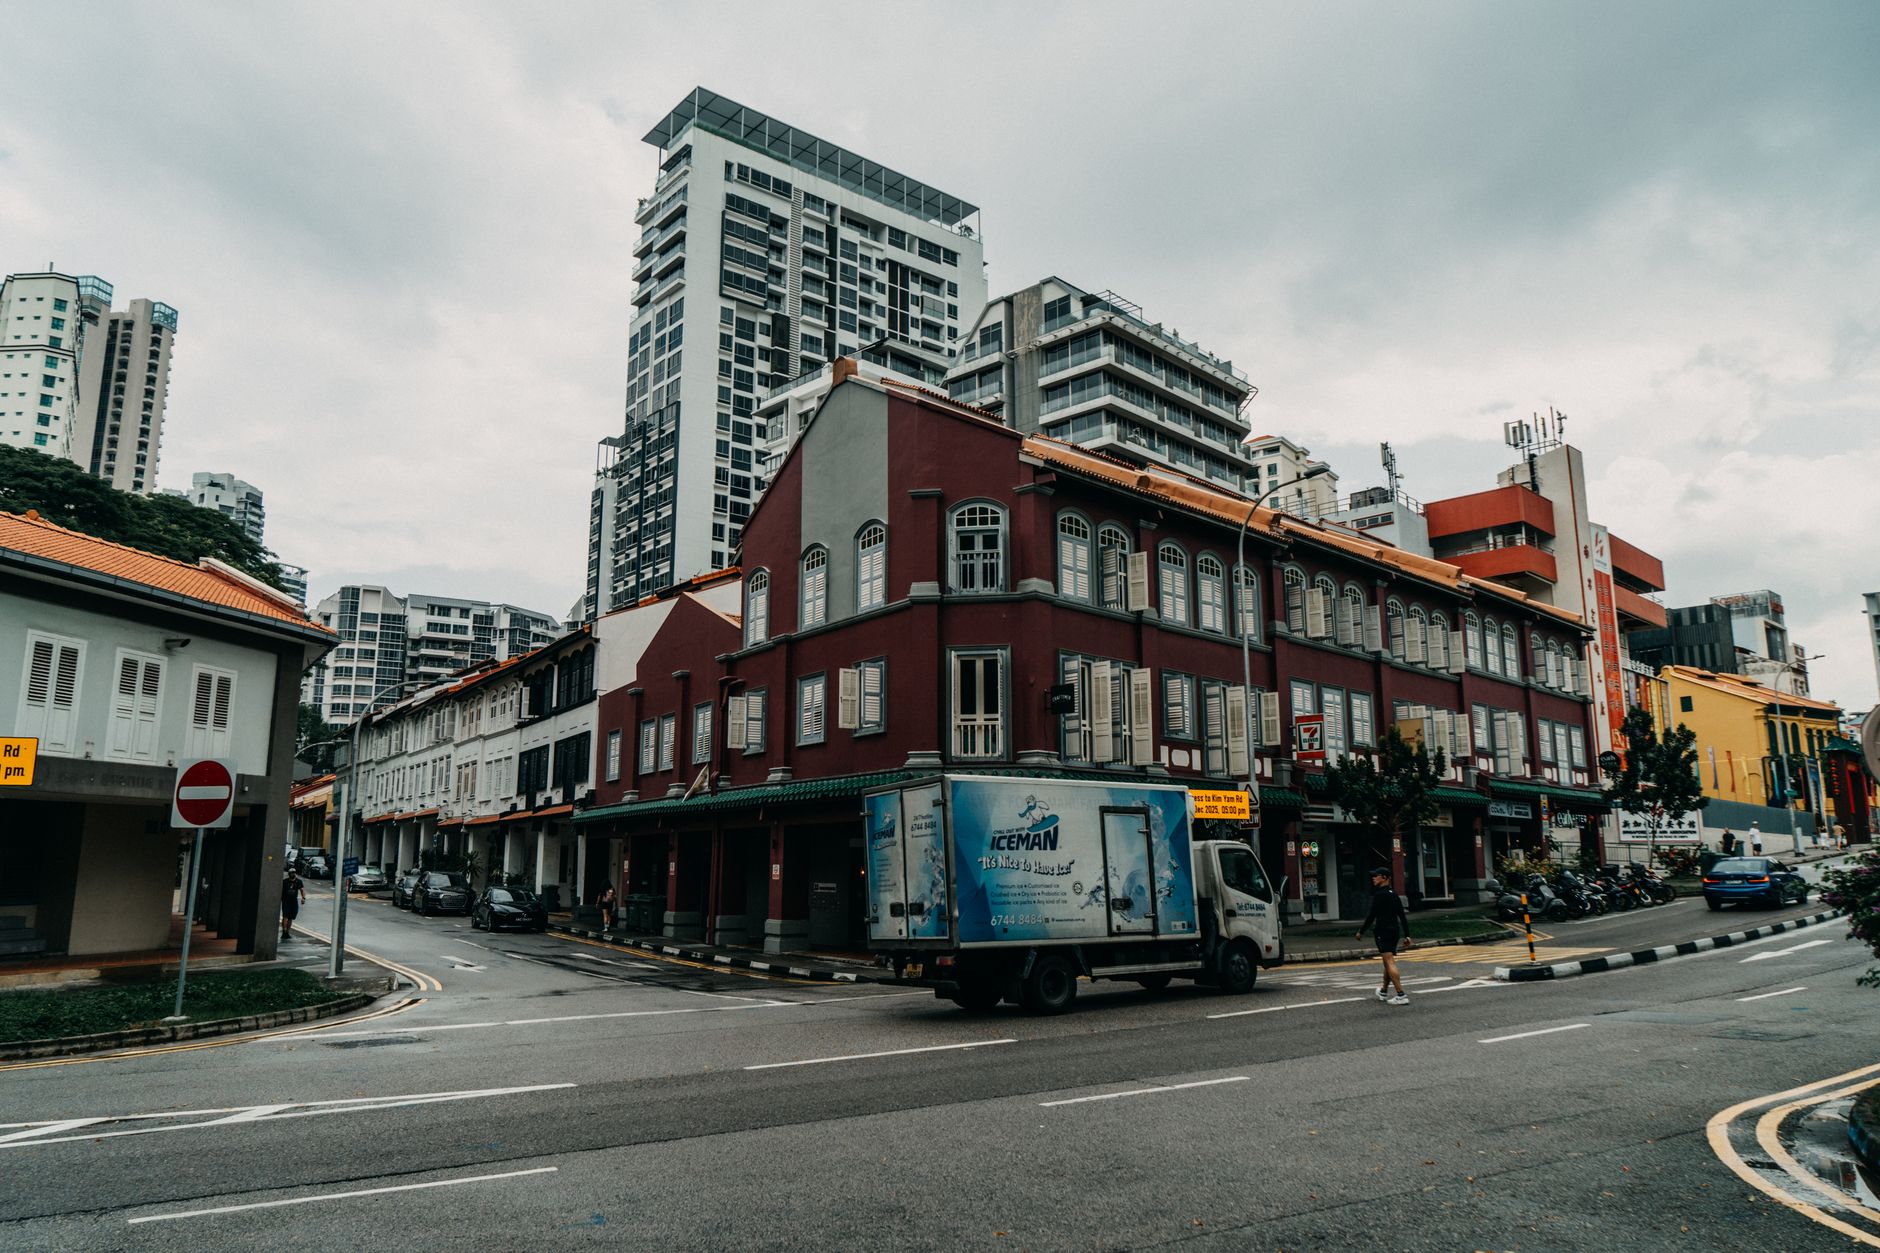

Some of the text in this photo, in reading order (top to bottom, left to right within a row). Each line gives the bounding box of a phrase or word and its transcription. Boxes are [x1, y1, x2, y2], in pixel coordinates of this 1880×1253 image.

[4, 745, 20, 757] Rd
[4, 767, 25, 779] pm
[1205, 794, 1211, 802] to
[1212, 794, 1222, 802] Kim
[1236, 795, 1243, 803] Rd
[1238, 808, 1247, 816] pm
[990, 825, 1059, 850] ICEMAN
[1000, 855, 1020, 870] Nice
[1021, 859, 1032, 871] To
[1034, 860, 1055, 875] Have
[990, 913, 1043, 927] 6744 8484
